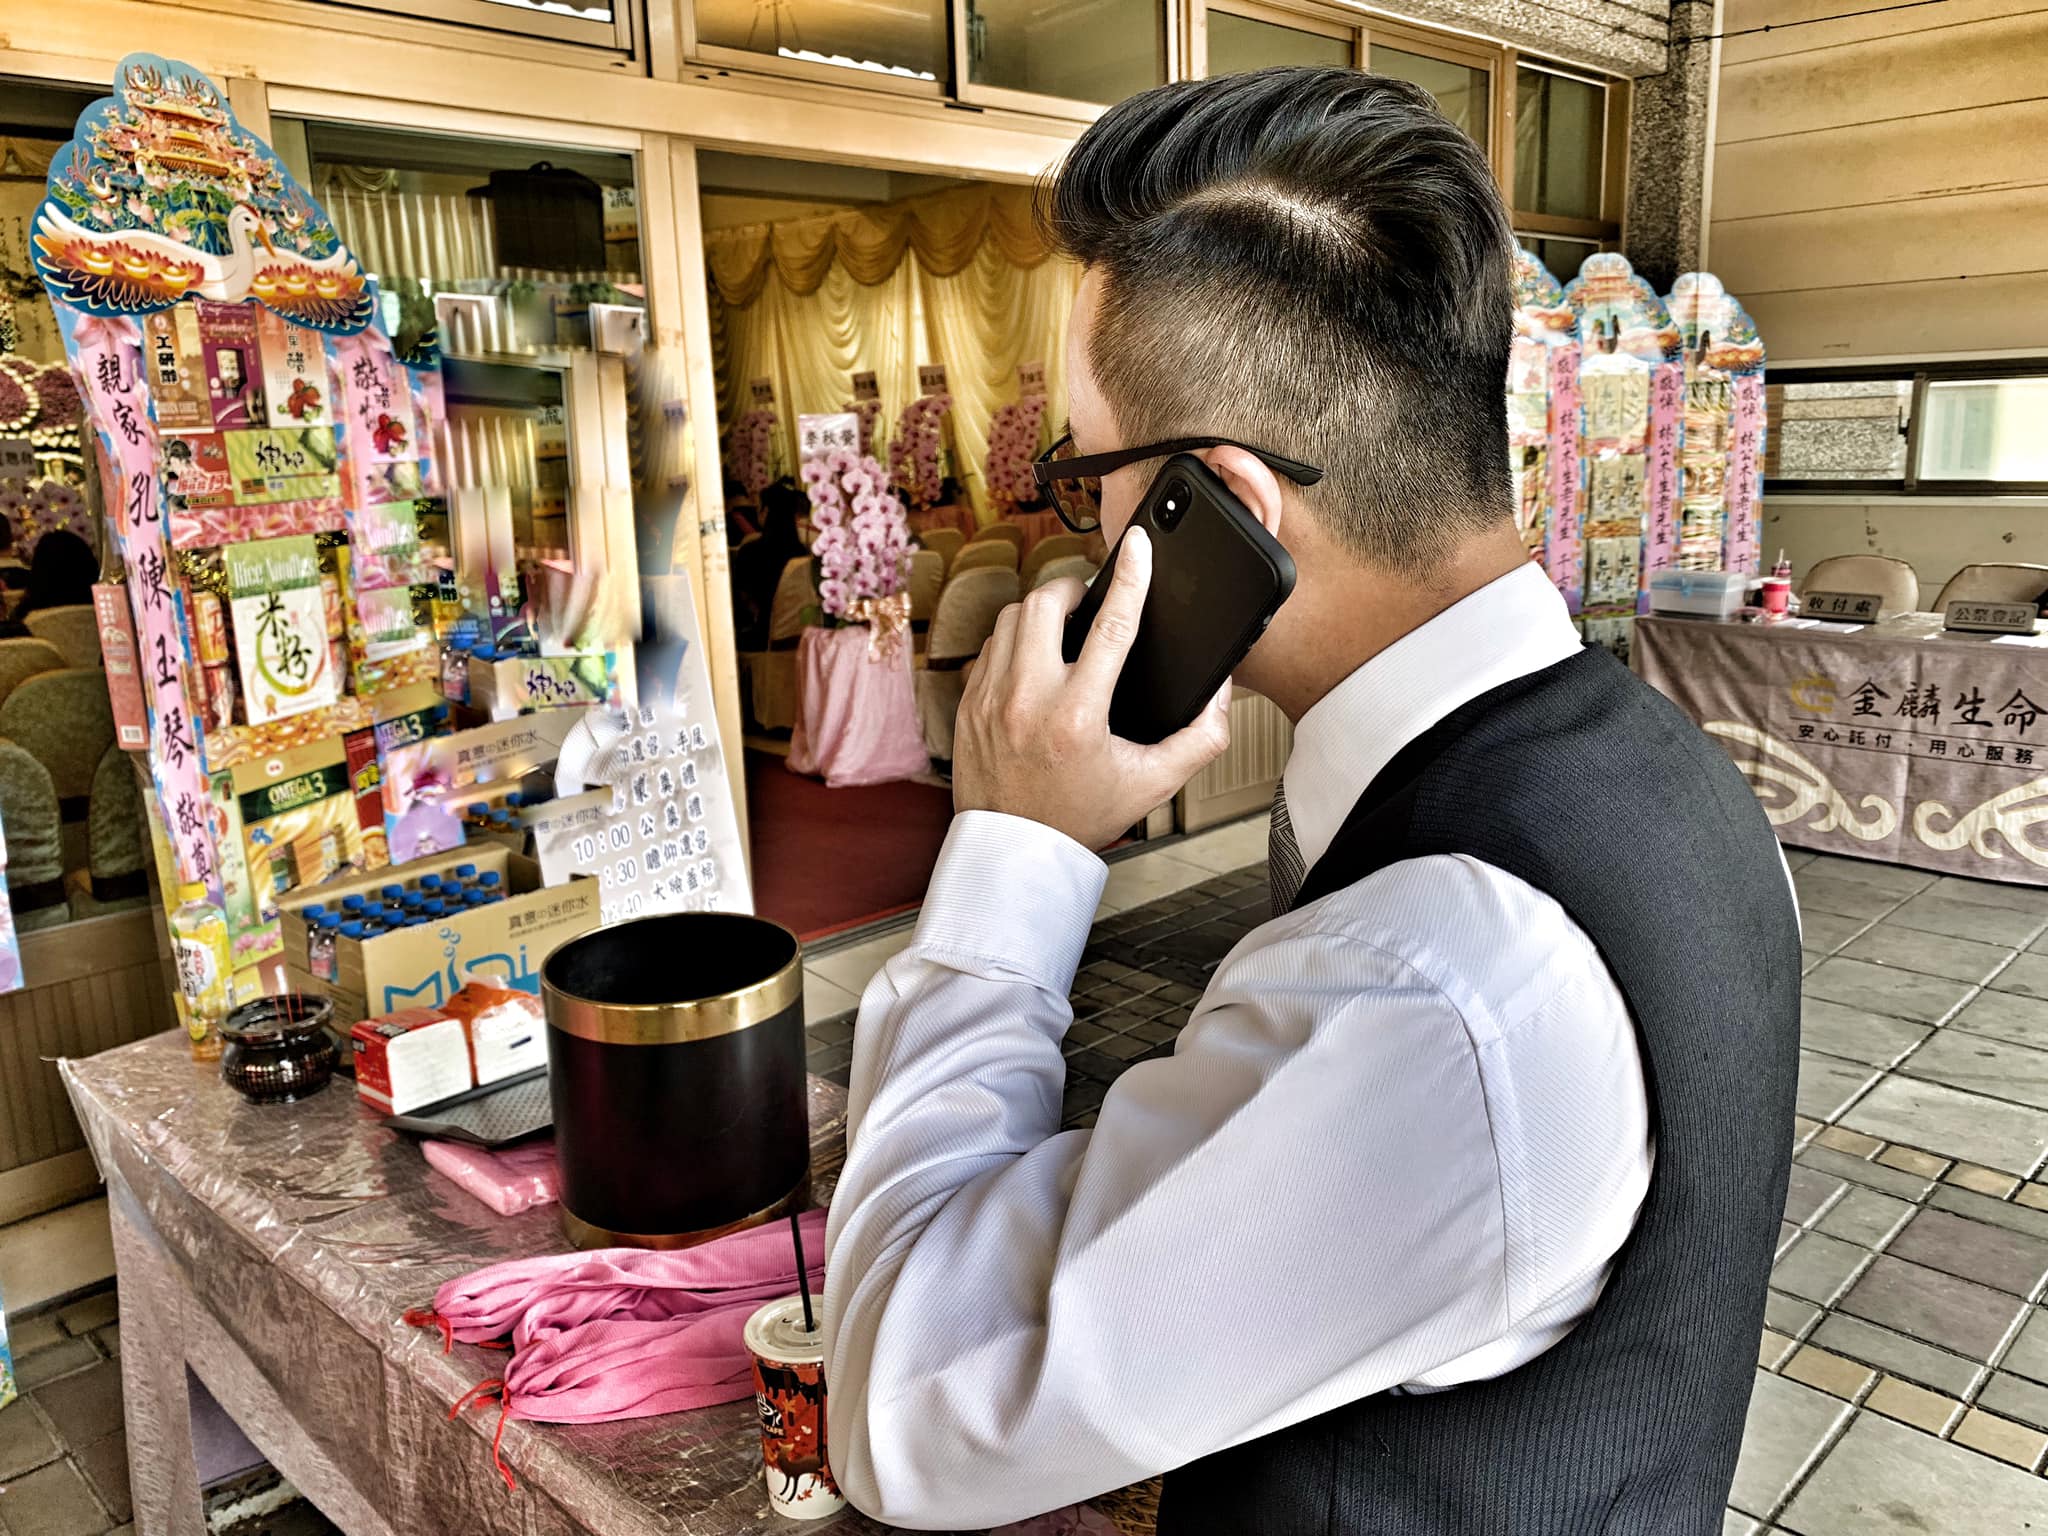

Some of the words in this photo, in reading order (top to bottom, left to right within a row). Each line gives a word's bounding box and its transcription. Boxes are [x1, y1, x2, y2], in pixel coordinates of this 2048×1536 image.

[255, 590, 313, 681] 米粉
[1843, 676, 2048, 736] 金麟生命
[268, 776, 313, 804] OMEGA
[312, 772, 327, 799] 3
